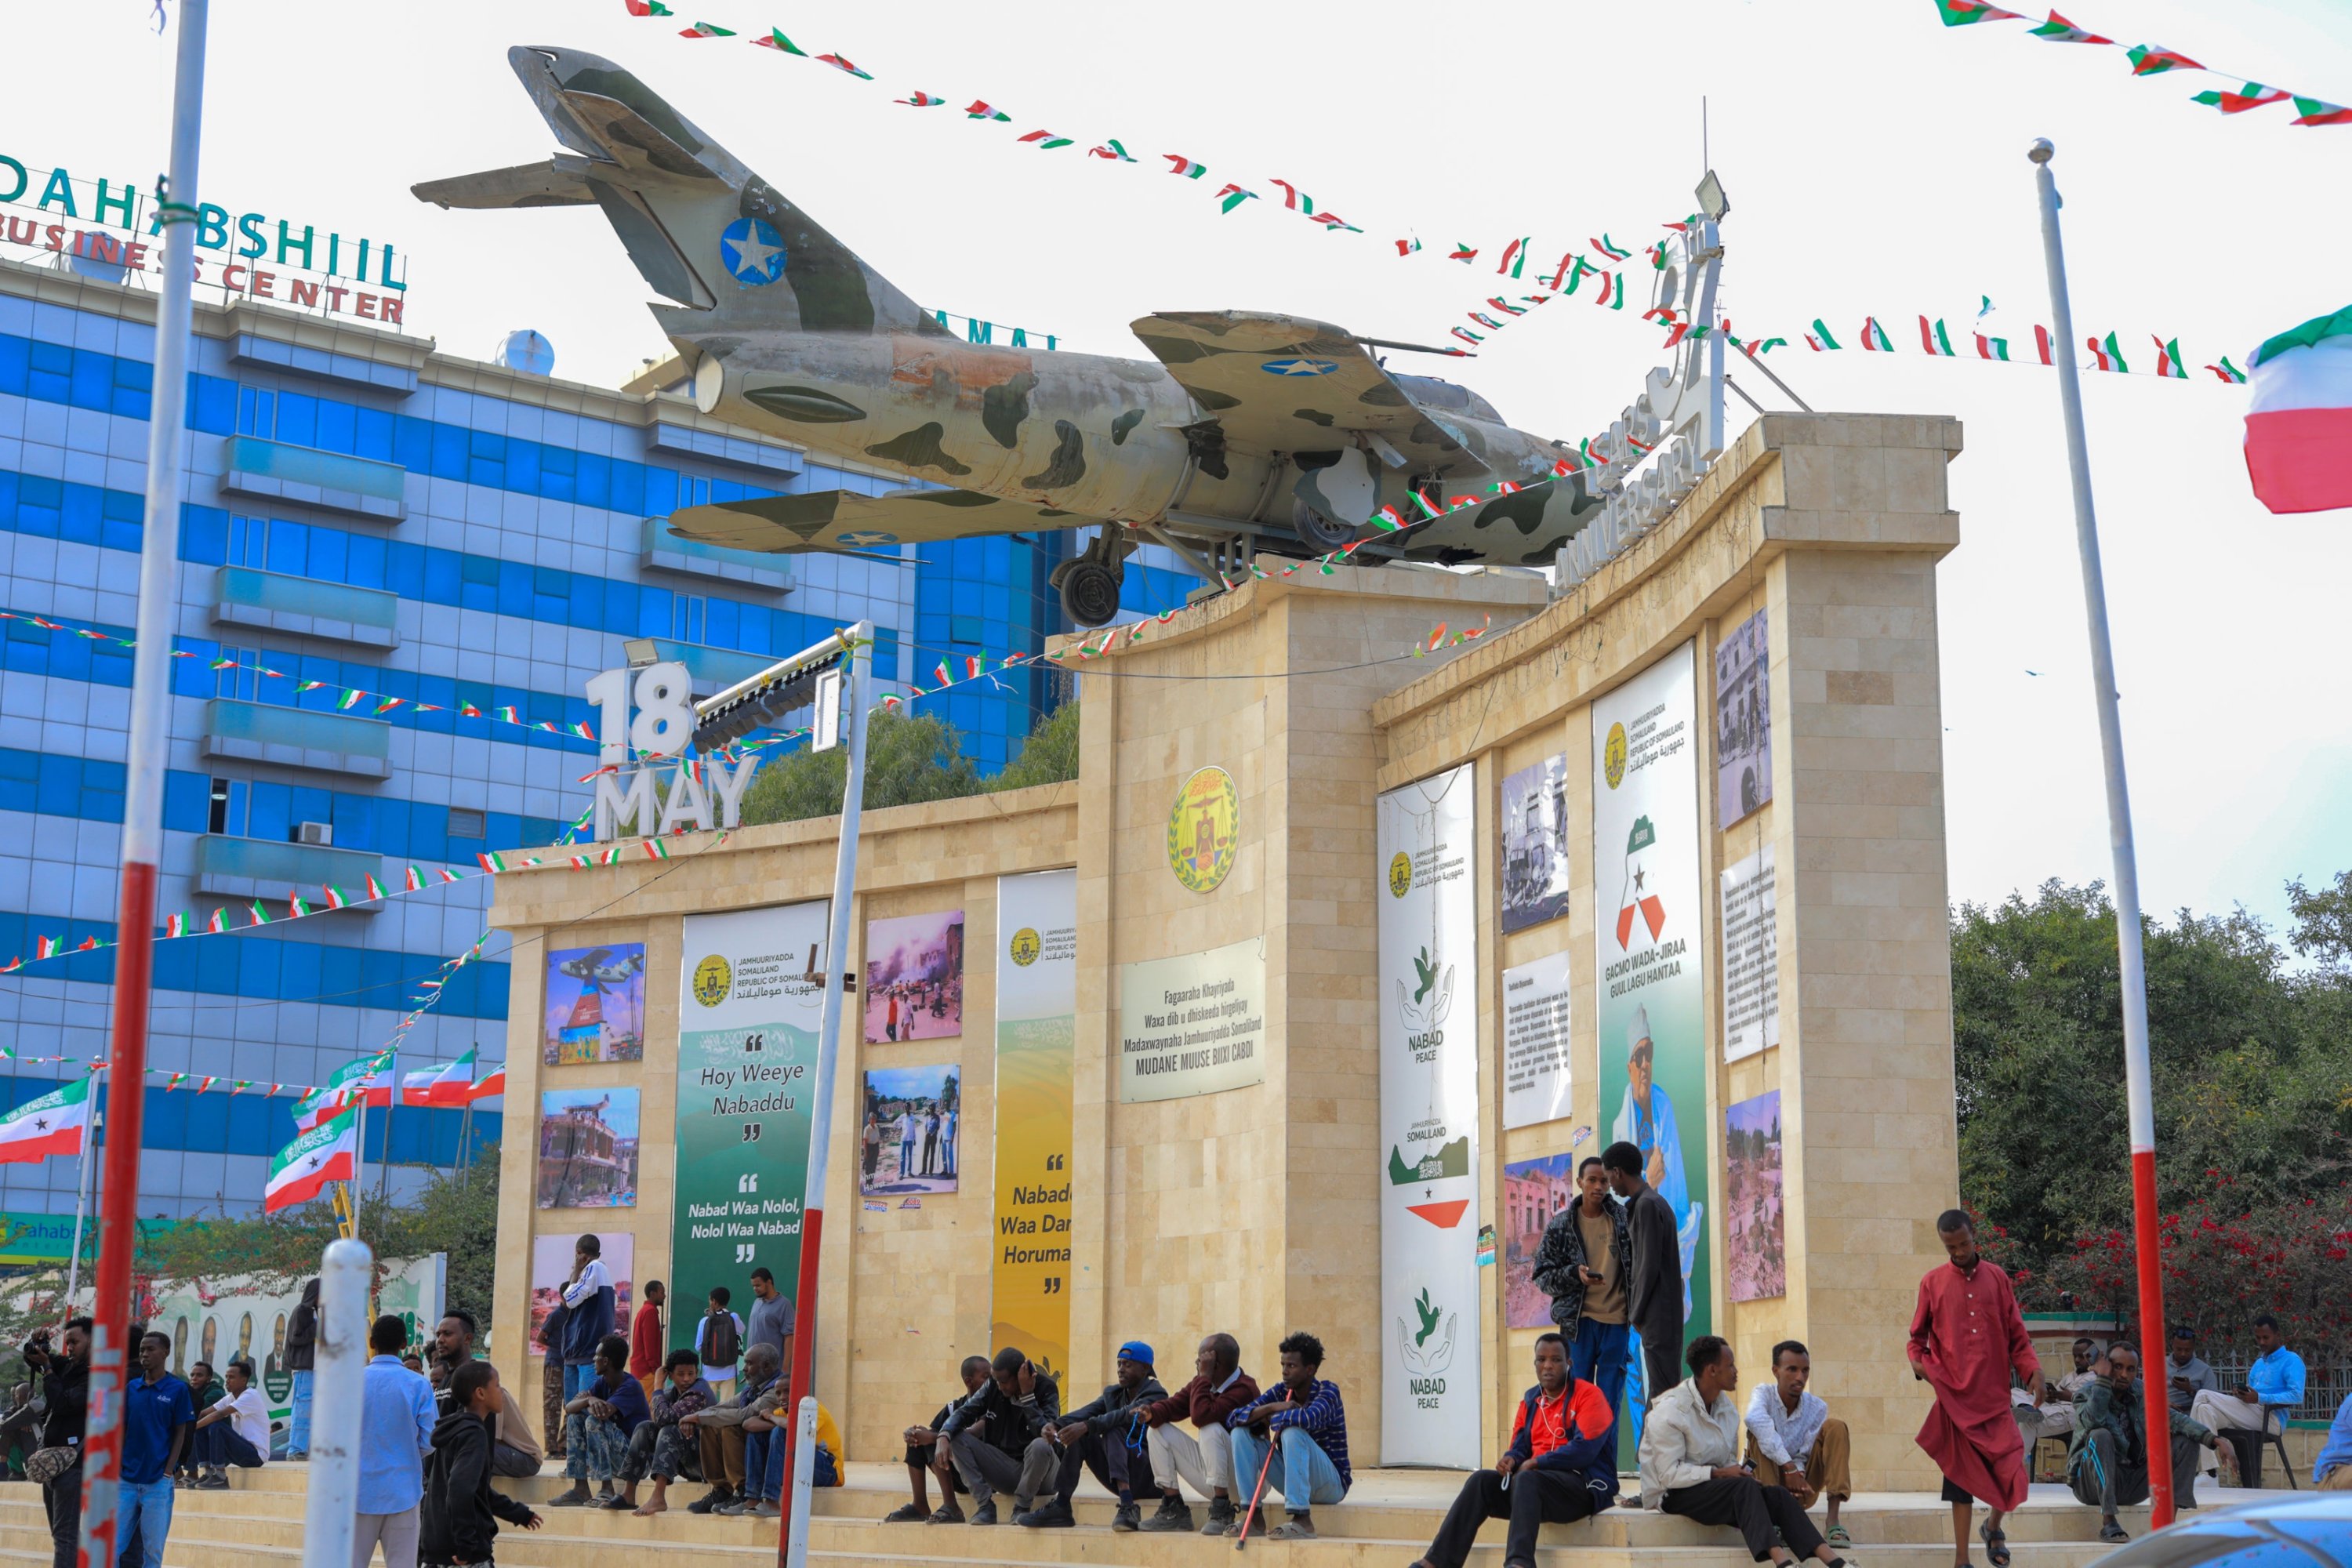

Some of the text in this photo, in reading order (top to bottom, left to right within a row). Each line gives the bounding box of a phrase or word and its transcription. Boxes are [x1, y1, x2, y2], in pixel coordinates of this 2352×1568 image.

[0, 154, 407, 292] DAHBSHIIL
[223, 264, 405, 324] CENTER
[1555, 419, 1708, 600] ANNIVERSARY
[585, 662, 695, 766] 18
[1630, 721, 1657, 744] SOMALILAND
[1630, 720, 1685, 758] REPUBLIC OF SOMALILAND
[594, 755, 761, 841] MAY
[1046, 927, 1076, 936] JAMHUURIY
[738, 965, 779, 976] SOMALILAND
[739, 953, 794, 966] JAMHUURIYADDA
[1605, 938, 1686, 982] GACMO WADA-JIRAA
[737, 976, 768, 987] REPUBLIC
[768, 976, 778, 985] OF
[1610, 960, 1682, 999] GUUL LAGU HANTAA
[1164, 978, 1235, 1006] Fagaaraha Khayriyada
[1145, 998, 1248, 1029] Waxa dib u dhiskeeda hirgeliyay
[1124, 1015, 1261, 1054] Madaxwaynaha Jamhuuriyadda Somaliland
[1409, 1029, 1443, 1052] NABAD
[1135, 1040, 1254, 1076] MUDANE MUUSE BIIXI CABDI
[1415, 1050, 1437, 1064] PEACE
[701, 1063, 804, 1091] Hoy Weeye
[713, 1091, 795, 1116] Nabaddu
[1406, 1127, 1446, 1142] SOMALILAND
[1012, 1183, 1072, 1206] Nabad
[688, 1198, 800, 1218] Nabad Waa Nolol,
[691, 1219, 800, 1239] Nolol Waa Nabad
[1000, 1216, 1036, 1235] Waa
[1410, 1377, 1446, 1396] NABAD
[1417, 1398, 1439, 1409] PEACE
